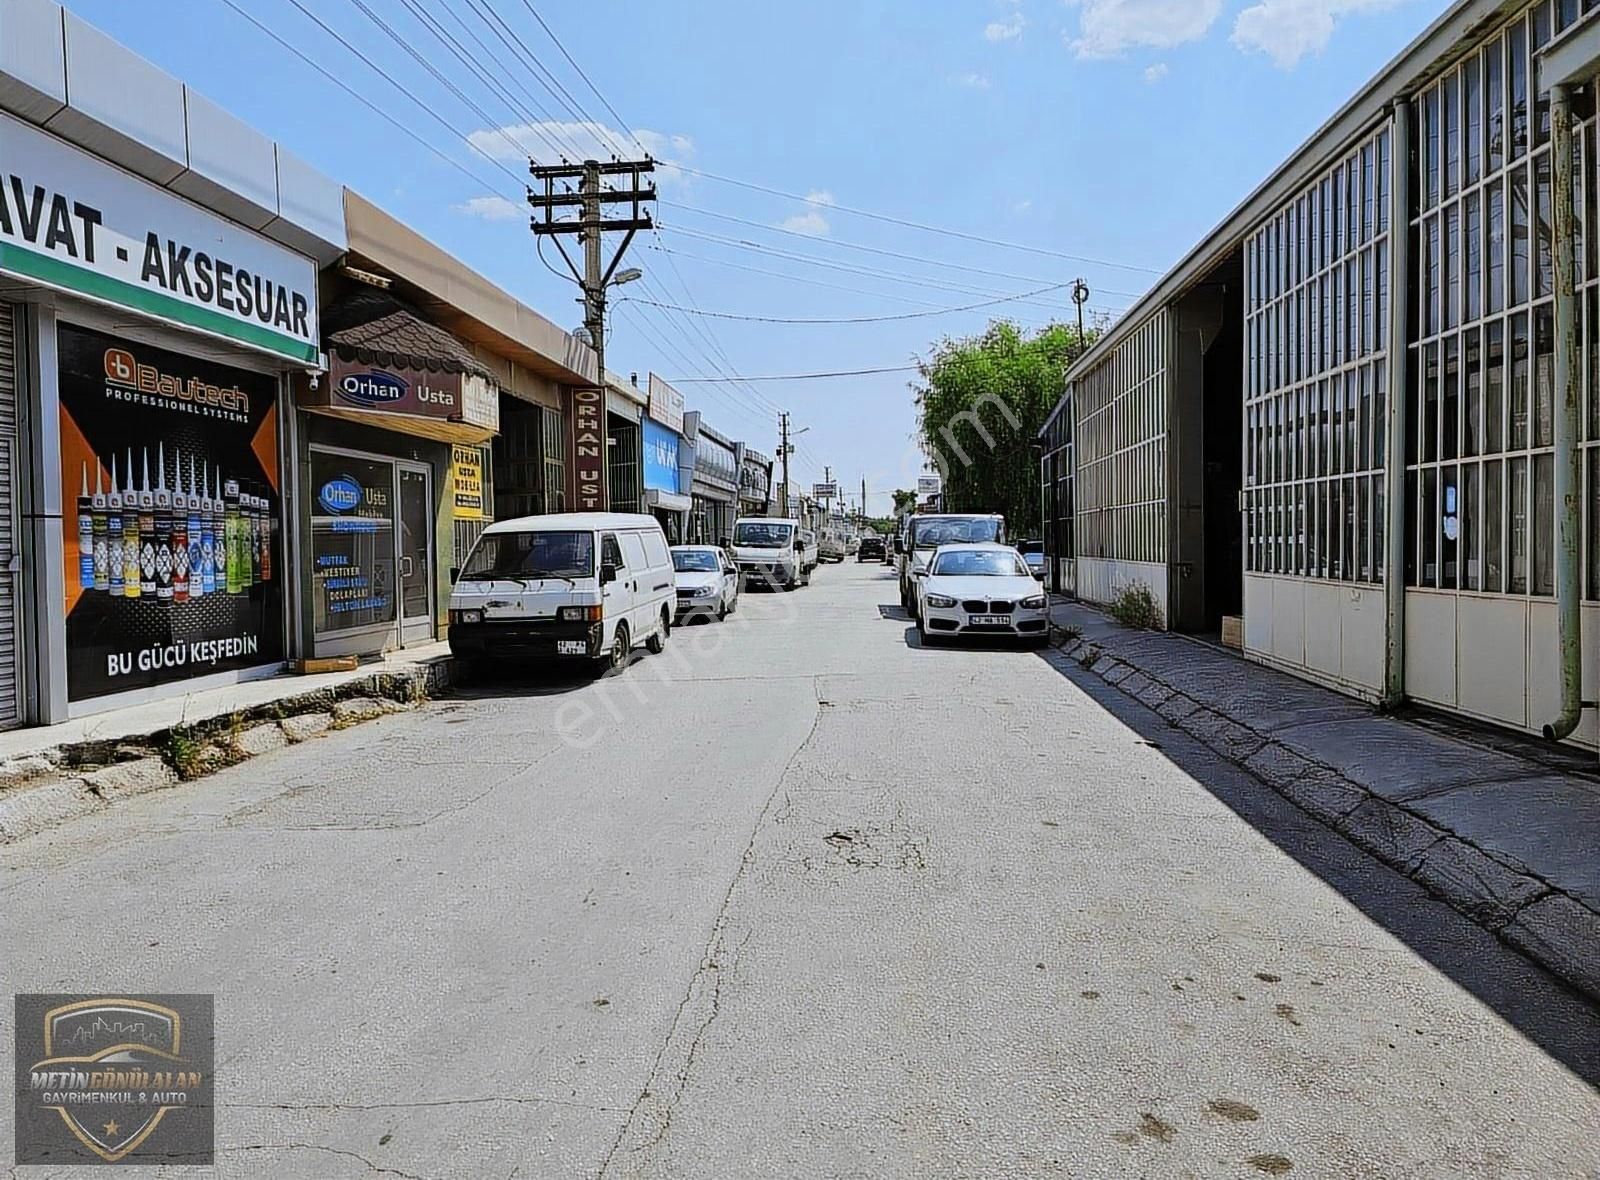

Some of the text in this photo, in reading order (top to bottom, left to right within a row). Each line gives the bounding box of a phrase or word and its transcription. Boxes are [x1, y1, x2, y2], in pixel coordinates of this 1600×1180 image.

[141, 231, 310, 338] AKSESUAR
[138, 363, 249, 413] Bautech
[344, 377, 400, 399] Orhan
[417, 385, 454, 406] Usta
[203, 407, 249, 424] SYSTEMS
[575, 391, 600, 508] ORHAN UST
[325, 483, 387, 506] Orhan Usta
[107, 631, 258, 677] BU GÜCÜ KEŞFEDİN
